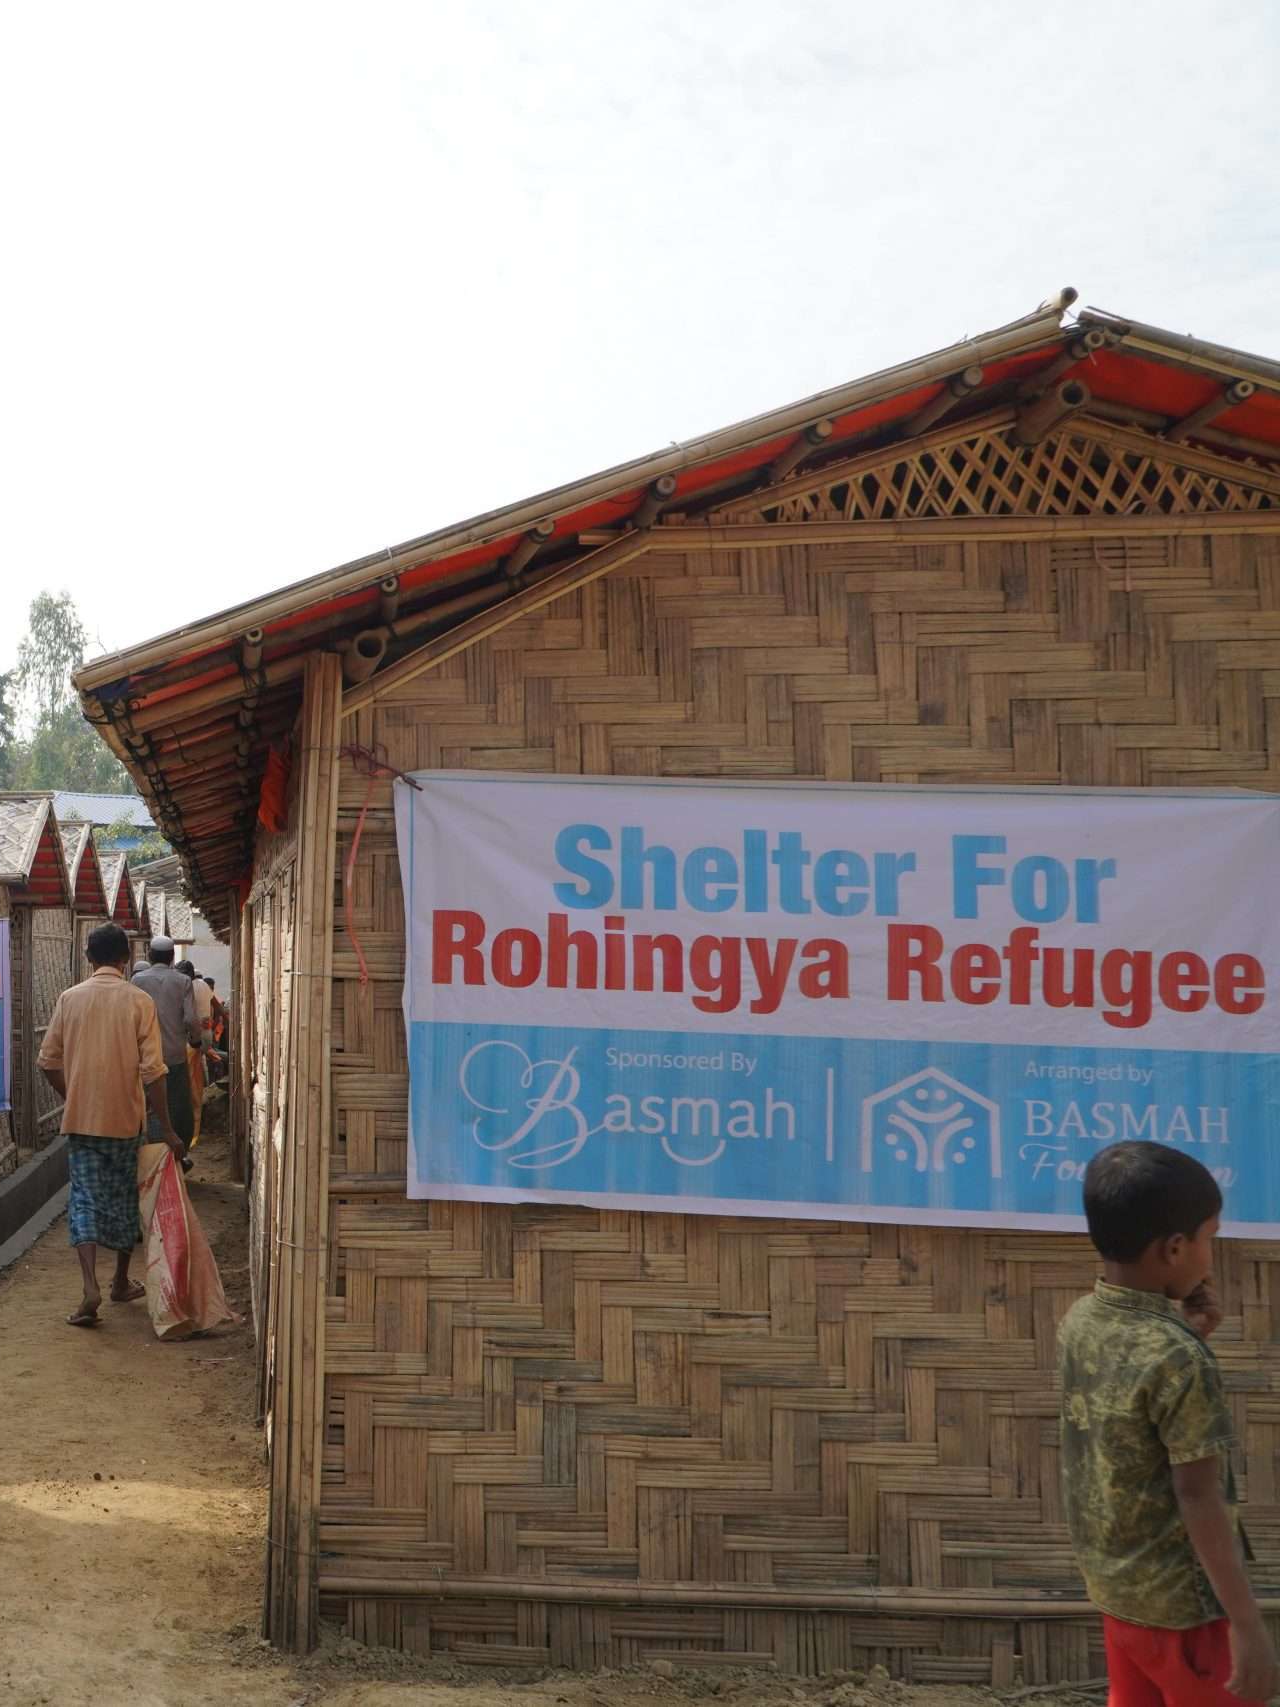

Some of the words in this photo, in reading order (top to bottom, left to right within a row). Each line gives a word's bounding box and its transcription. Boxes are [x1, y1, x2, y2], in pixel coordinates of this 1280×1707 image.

[553, 823, 916, 917] Shelter
[952, 834, 1117, 924] For
[431, 909, 850, 1015] Rohingya
[887, 923, 1266, 1029] Refugee
[606, 1047, 724, 1071] Sponsored
[731, 1051, 758, 1077] By
[1024, 1060, 1122, 1085] Arranged
[1128, 1064, 1153, 1086] by
[458, 1039, 796, 1169] Basmah
[1024, 1099, 1231, 1144] BASMAH
